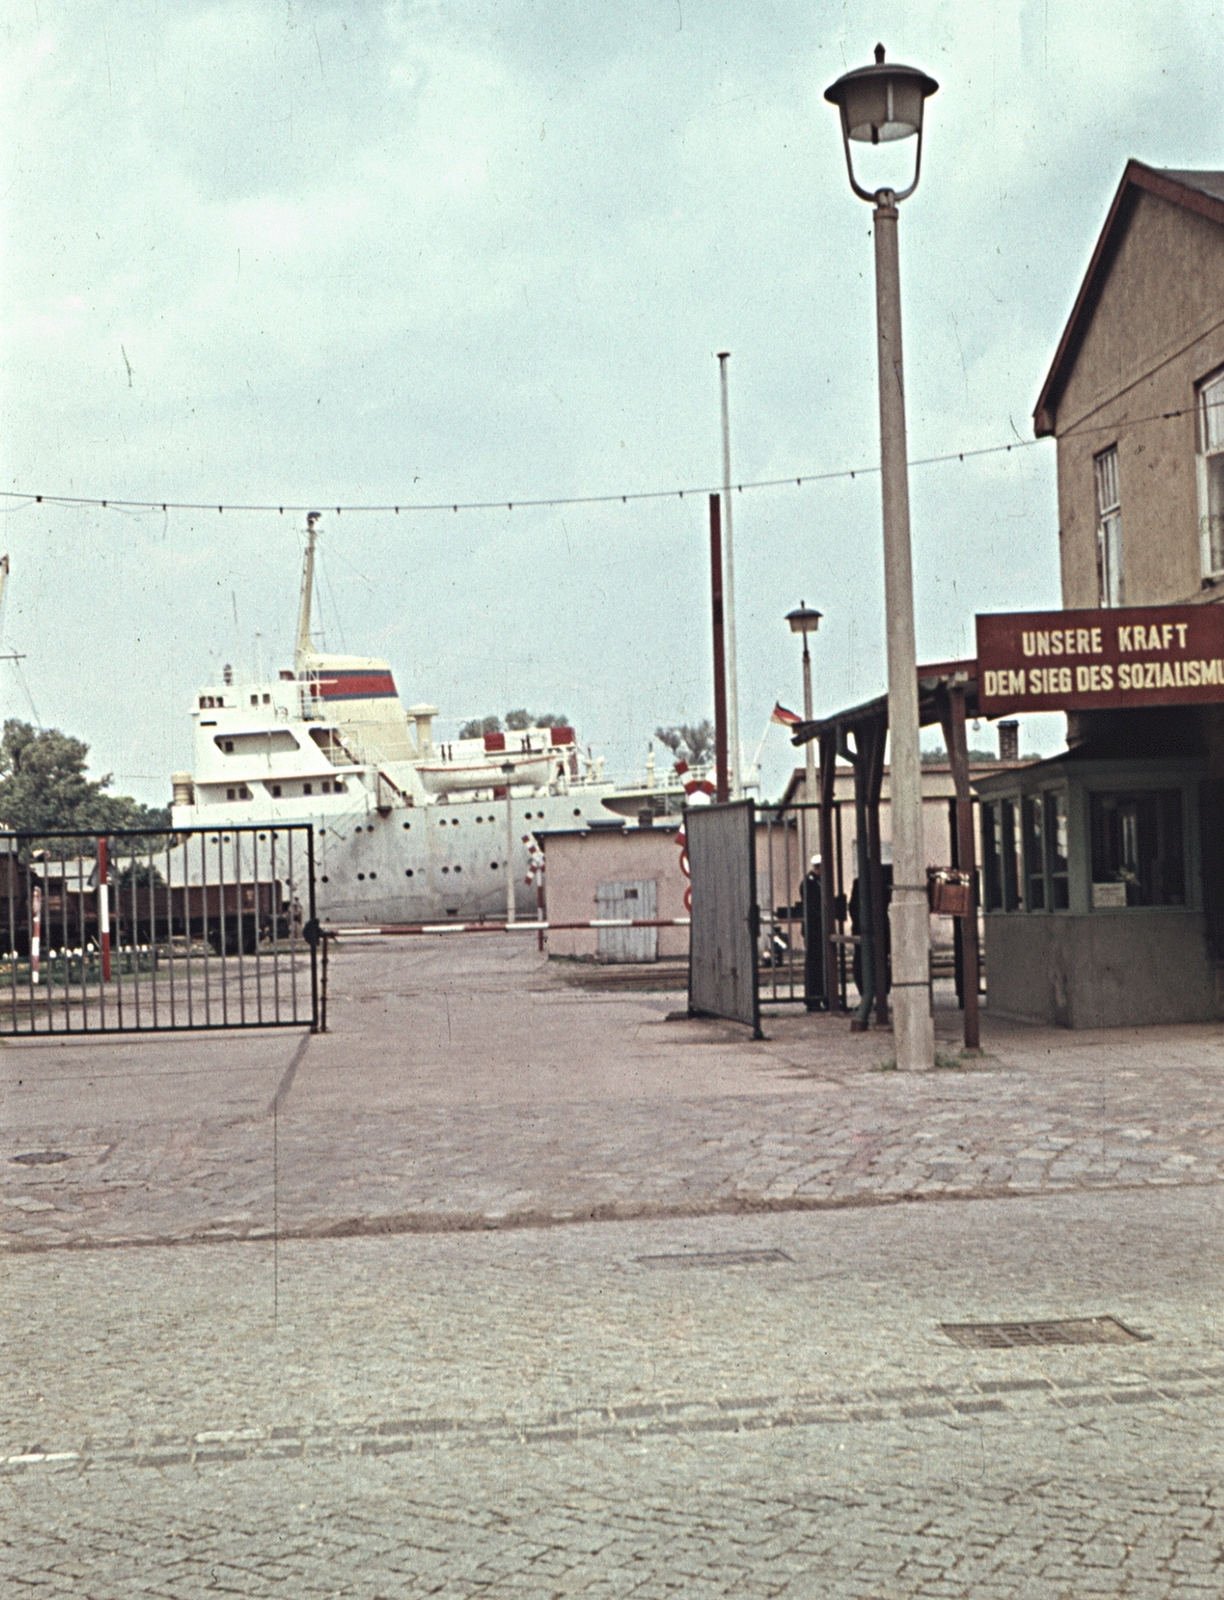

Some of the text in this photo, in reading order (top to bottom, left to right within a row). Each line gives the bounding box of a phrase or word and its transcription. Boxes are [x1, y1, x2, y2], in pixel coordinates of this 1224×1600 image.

[1022, 624, 1188, 656] UNSERE KRAFT
[984, 670, 1026, 696] DEM
[1029, 667, 1072, 694] SIEG
[1076, 664, 1114, 692] DES
